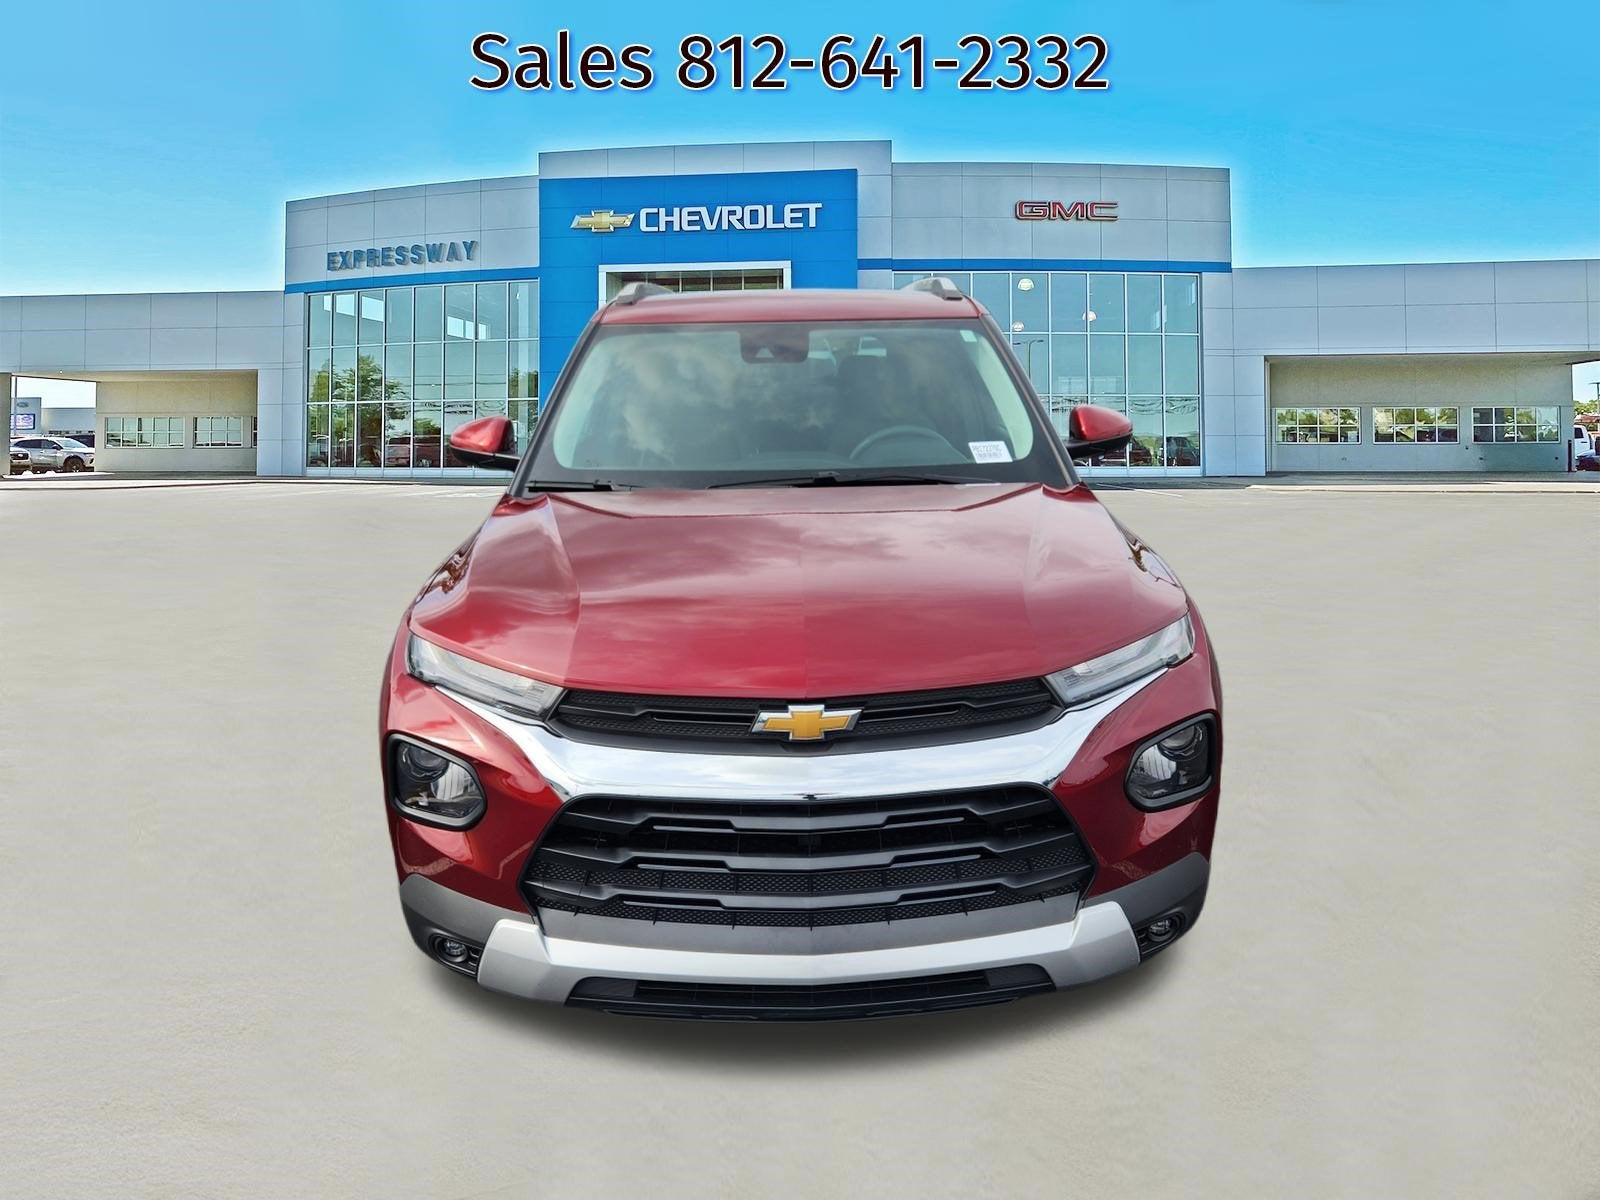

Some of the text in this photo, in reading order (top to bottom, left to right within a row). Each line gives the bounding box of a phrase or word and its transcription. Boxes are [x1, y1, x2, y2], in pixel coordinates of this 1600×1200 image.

[639, 203, 823, 232] CHEVROLET
[1015, 200, 1119, 221] GMC
[327, 240, 479, 272] EXPRESSWAY
